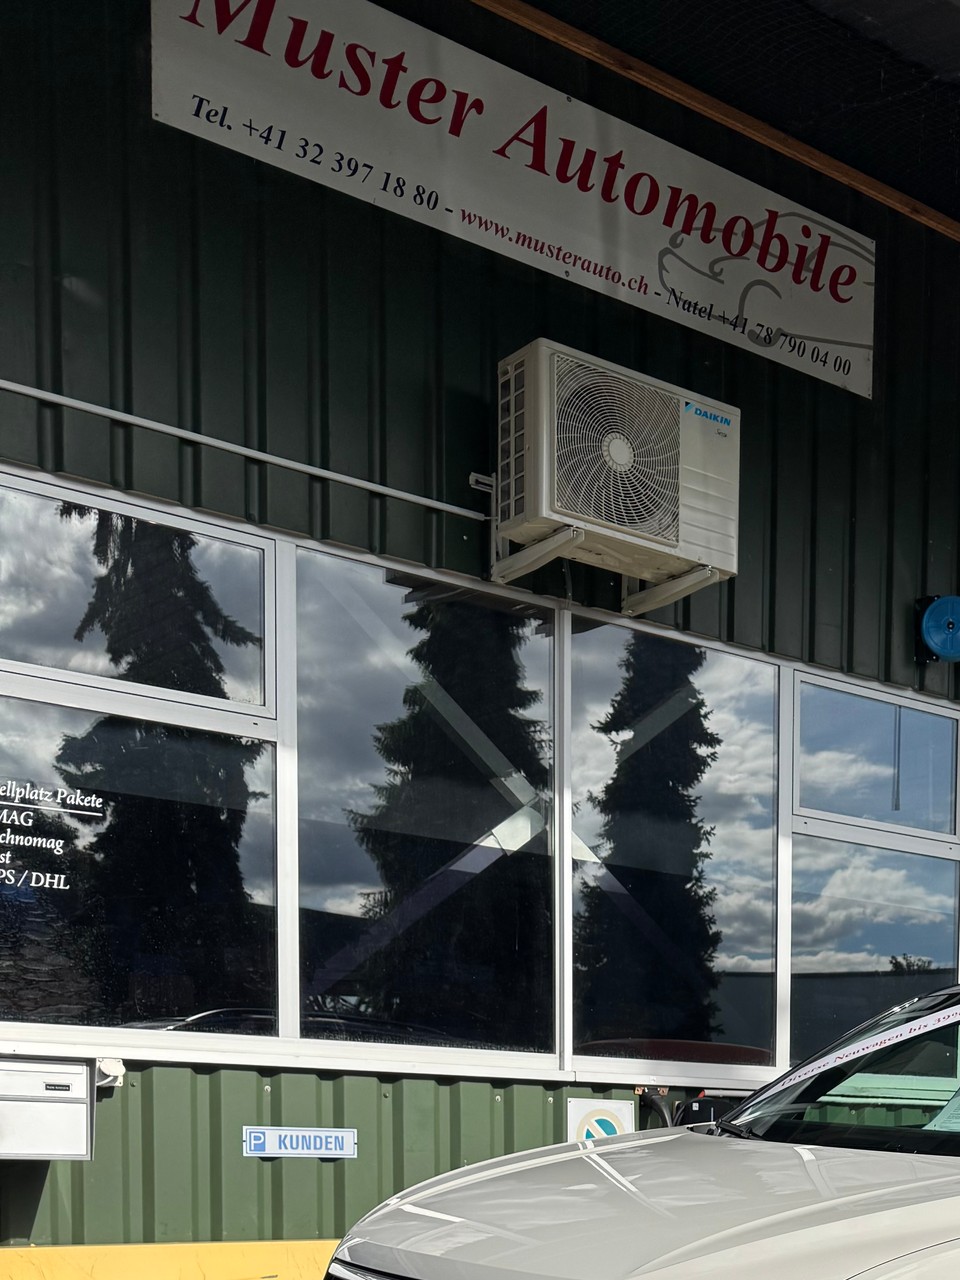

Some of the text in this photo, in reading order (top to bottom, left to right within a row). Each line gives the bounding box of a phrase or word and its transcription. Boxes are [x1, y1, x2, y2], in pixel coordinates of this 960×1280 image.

[179, 0, 858, 304] Muster Automobile
[191, 94, 233, 130] Tel.
[242, 118, 287, 151] +41
[295, 137, 325, 166] 32
[331, 151, 374, 184] 397
[379, 171, 407, 198] 18
[413, 184, 439, 211] 80
[460, 206, 650, 297] www.musterauto.ch
[666, 287, 714, 321] Natel
[718, 310, 748, 335] +41
[755, 322, 774, 345] 78
[779, 332, 807, 358] 790
[811, 346, 829, 368] 04
[833, 355, 852, 376] 00
[694, 407, 731, 427] DAIKIN
[56, 788, 104, 808] Pakete
[0, 828, 65, 855] chnomag
[17, 869, 29, 887] /
[30, 871, 70, 890] DHL
[833, 1032, 904, 1064] Neuwagen
[908, 1023, 929, 1035] bis
[250, 1132, 345, 1152] P KUNDEN
